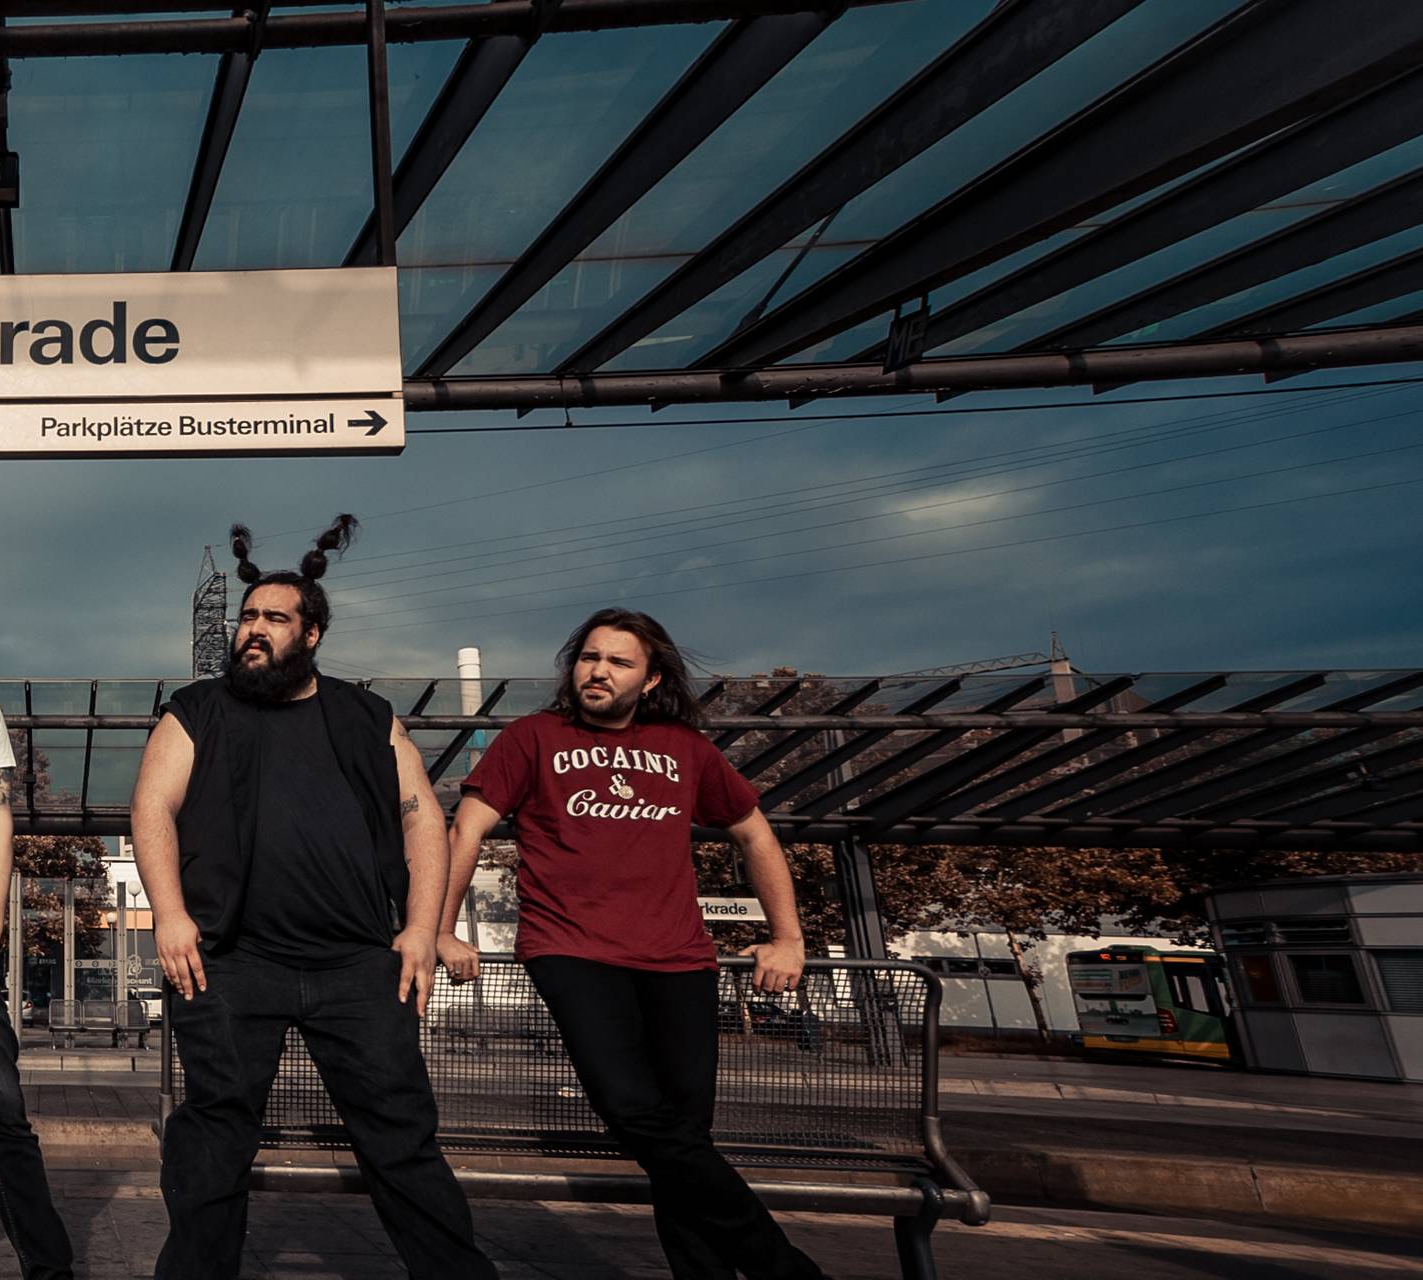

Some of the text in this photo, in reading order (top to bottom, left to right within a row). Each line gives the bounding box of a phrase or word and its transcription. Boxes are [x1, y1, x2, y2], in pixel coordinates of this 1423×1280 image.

[41, 413, 335, 441] Parkplätze Busterminal
[553, 746, 680, 782] COCAINE
[566, 788, 681, 820] Caviar
[699, 902, 748, 915] rkrade
